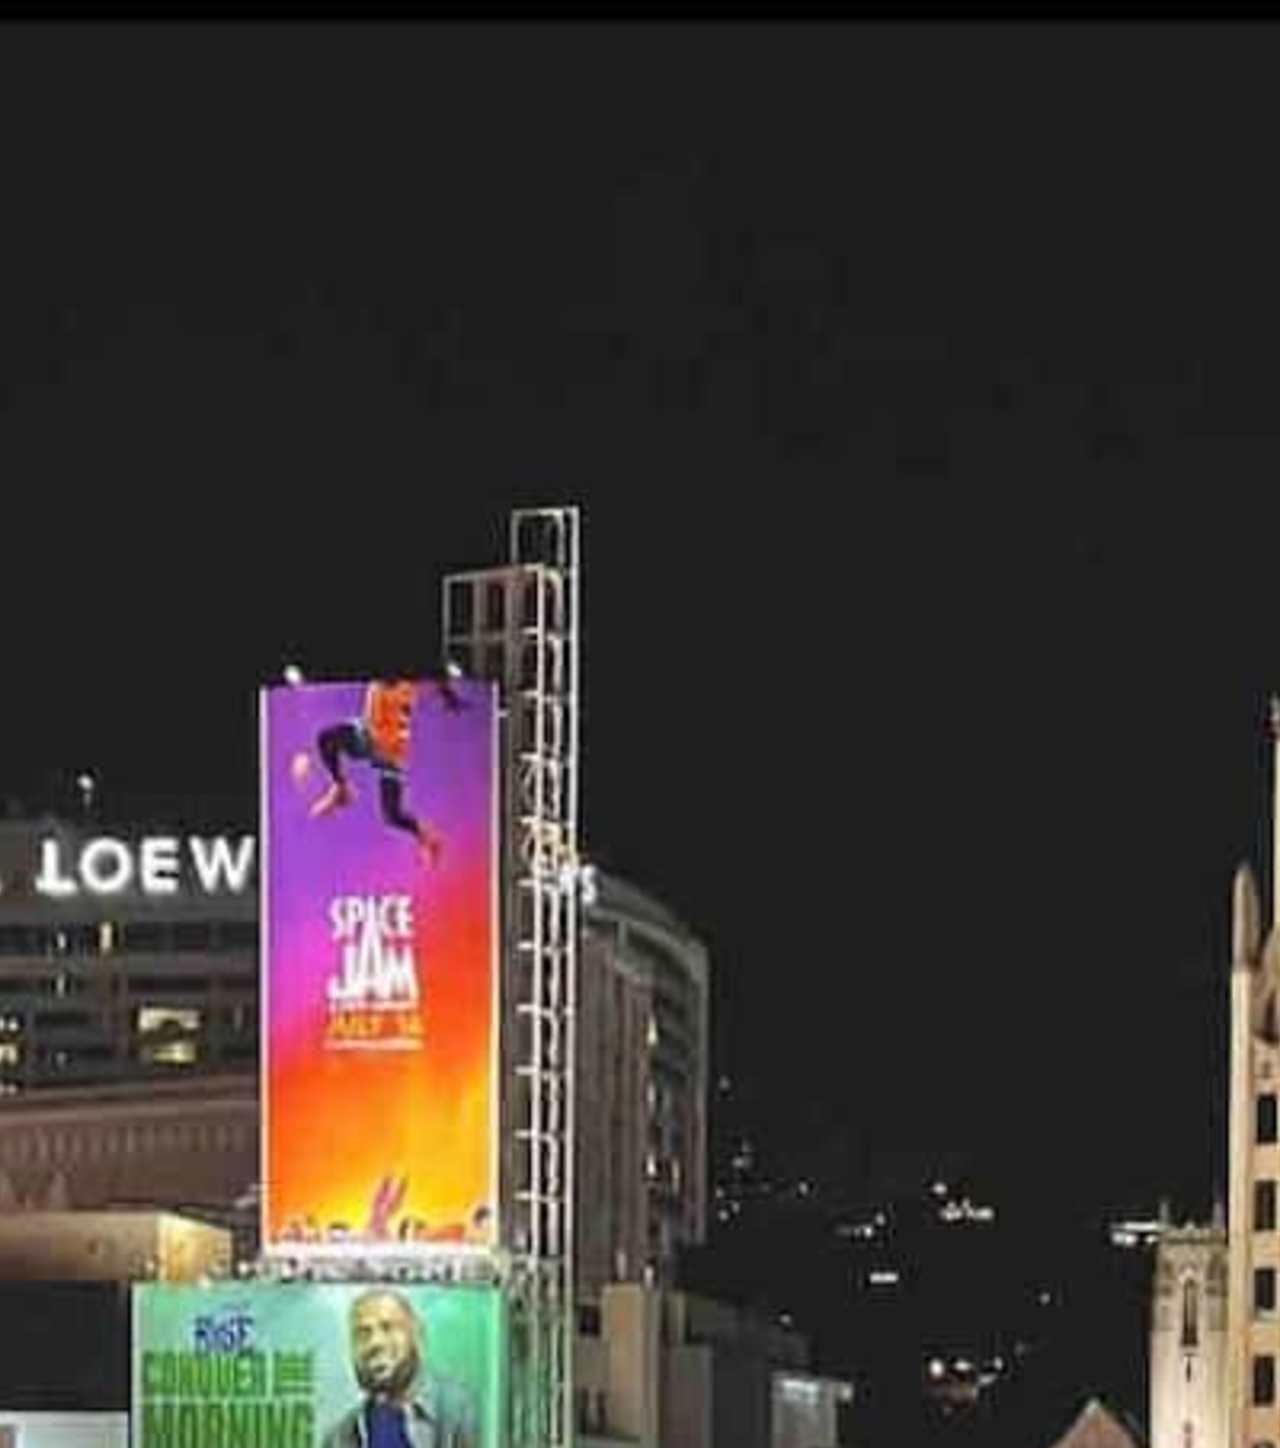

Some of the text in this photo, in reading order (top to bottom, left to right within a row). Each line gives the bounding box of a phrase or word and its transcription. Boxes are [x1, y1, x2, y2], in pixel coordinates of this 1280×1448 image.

[329, 893, 415, 941] SPACE
[327, 934, 420, 1001] JAM
[143, 1351, 267, 1398] CONQUER
